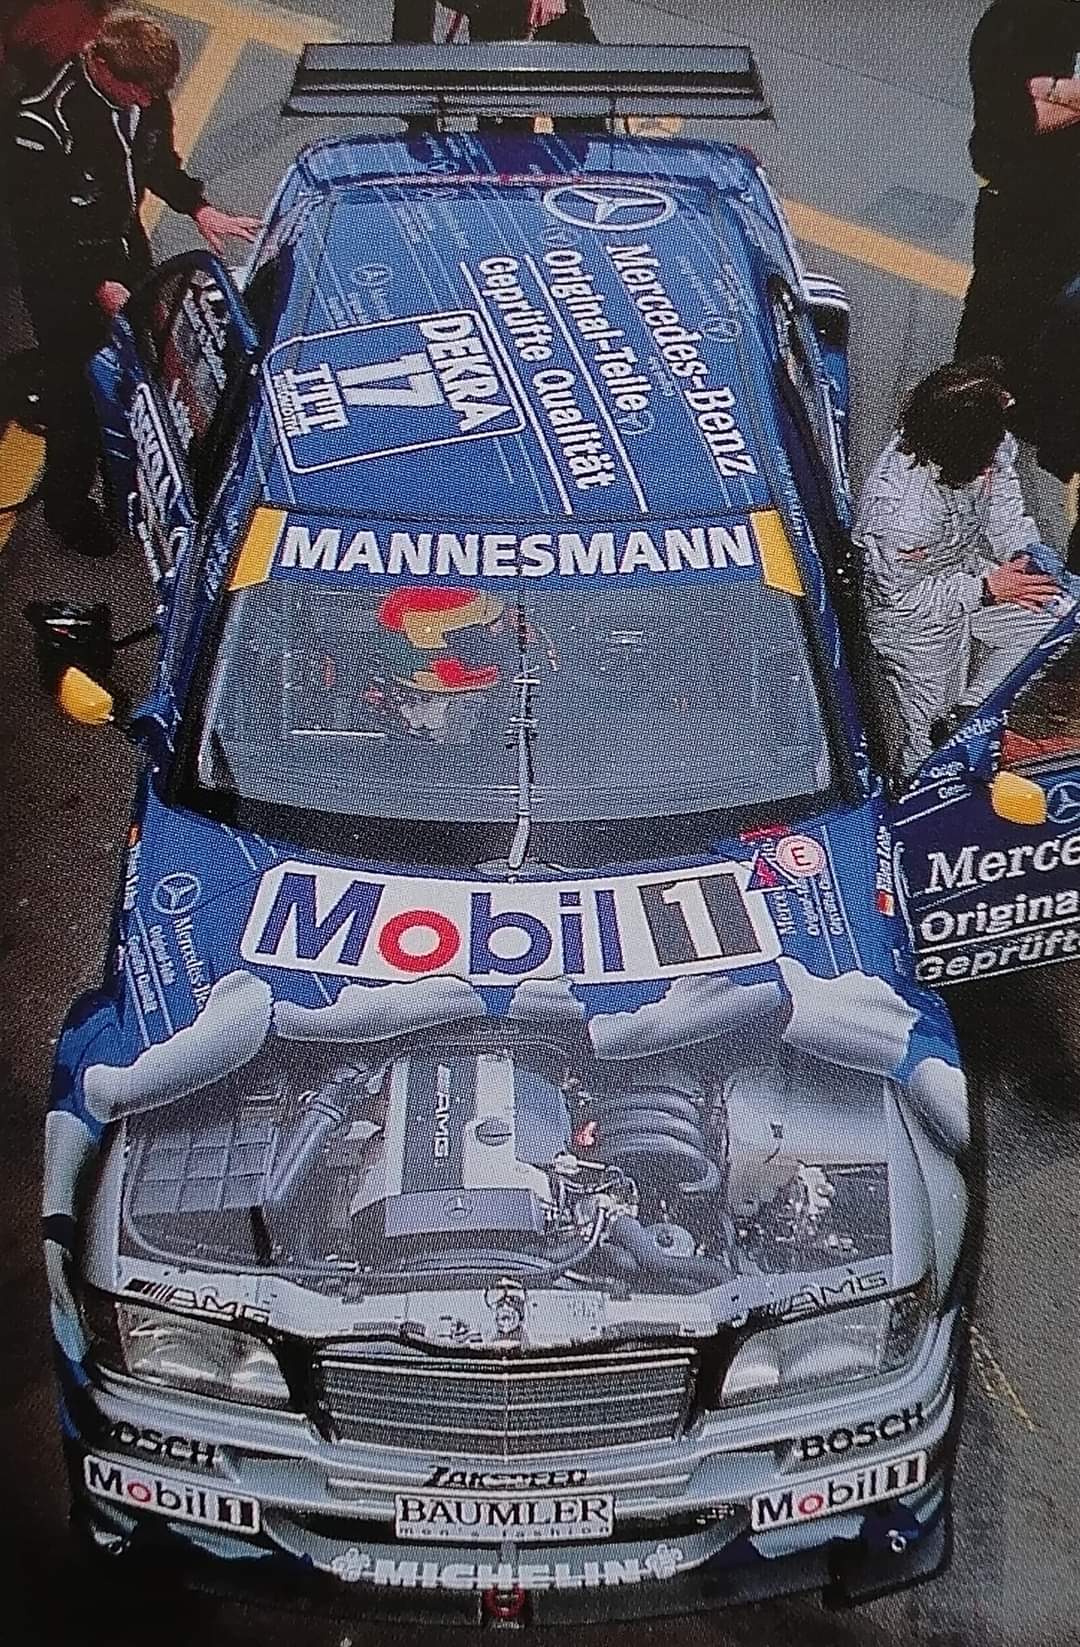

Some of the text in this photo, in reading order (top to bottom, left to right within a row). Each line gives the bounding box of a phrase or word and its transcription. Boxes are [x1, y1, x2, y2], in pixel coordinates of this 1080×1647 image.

[542, 249, 652, 412] Original-Teile
[335, 350, 446, 408] 17
[418, 315, 513, 432] DEKRA
[478, 256, 616, 490] Geprüfte Qualität
[606, 242, 757, 478] Mercedes-Benz
[281, 525, 756, 578] MANNESMANN
[791, 846, 812, 866] E
[925, 836, 1080, 894] Merce
[256, 872, 723, 976] Mobil 1
[434, 1091, 450, 1159] AMG
[172, 1287, 269, 1324] AMG
[785, 1270, 888, 1316] AMG
[108, 1420, 218, 1468] OSCH
[801, 1403, 927, 1460] BOSCH
[89, 1462, 207, 1519] Mobil
[757, 1474, 880, 1527] Mobil
[374, 1558, 642, 1589] MICHELIN
